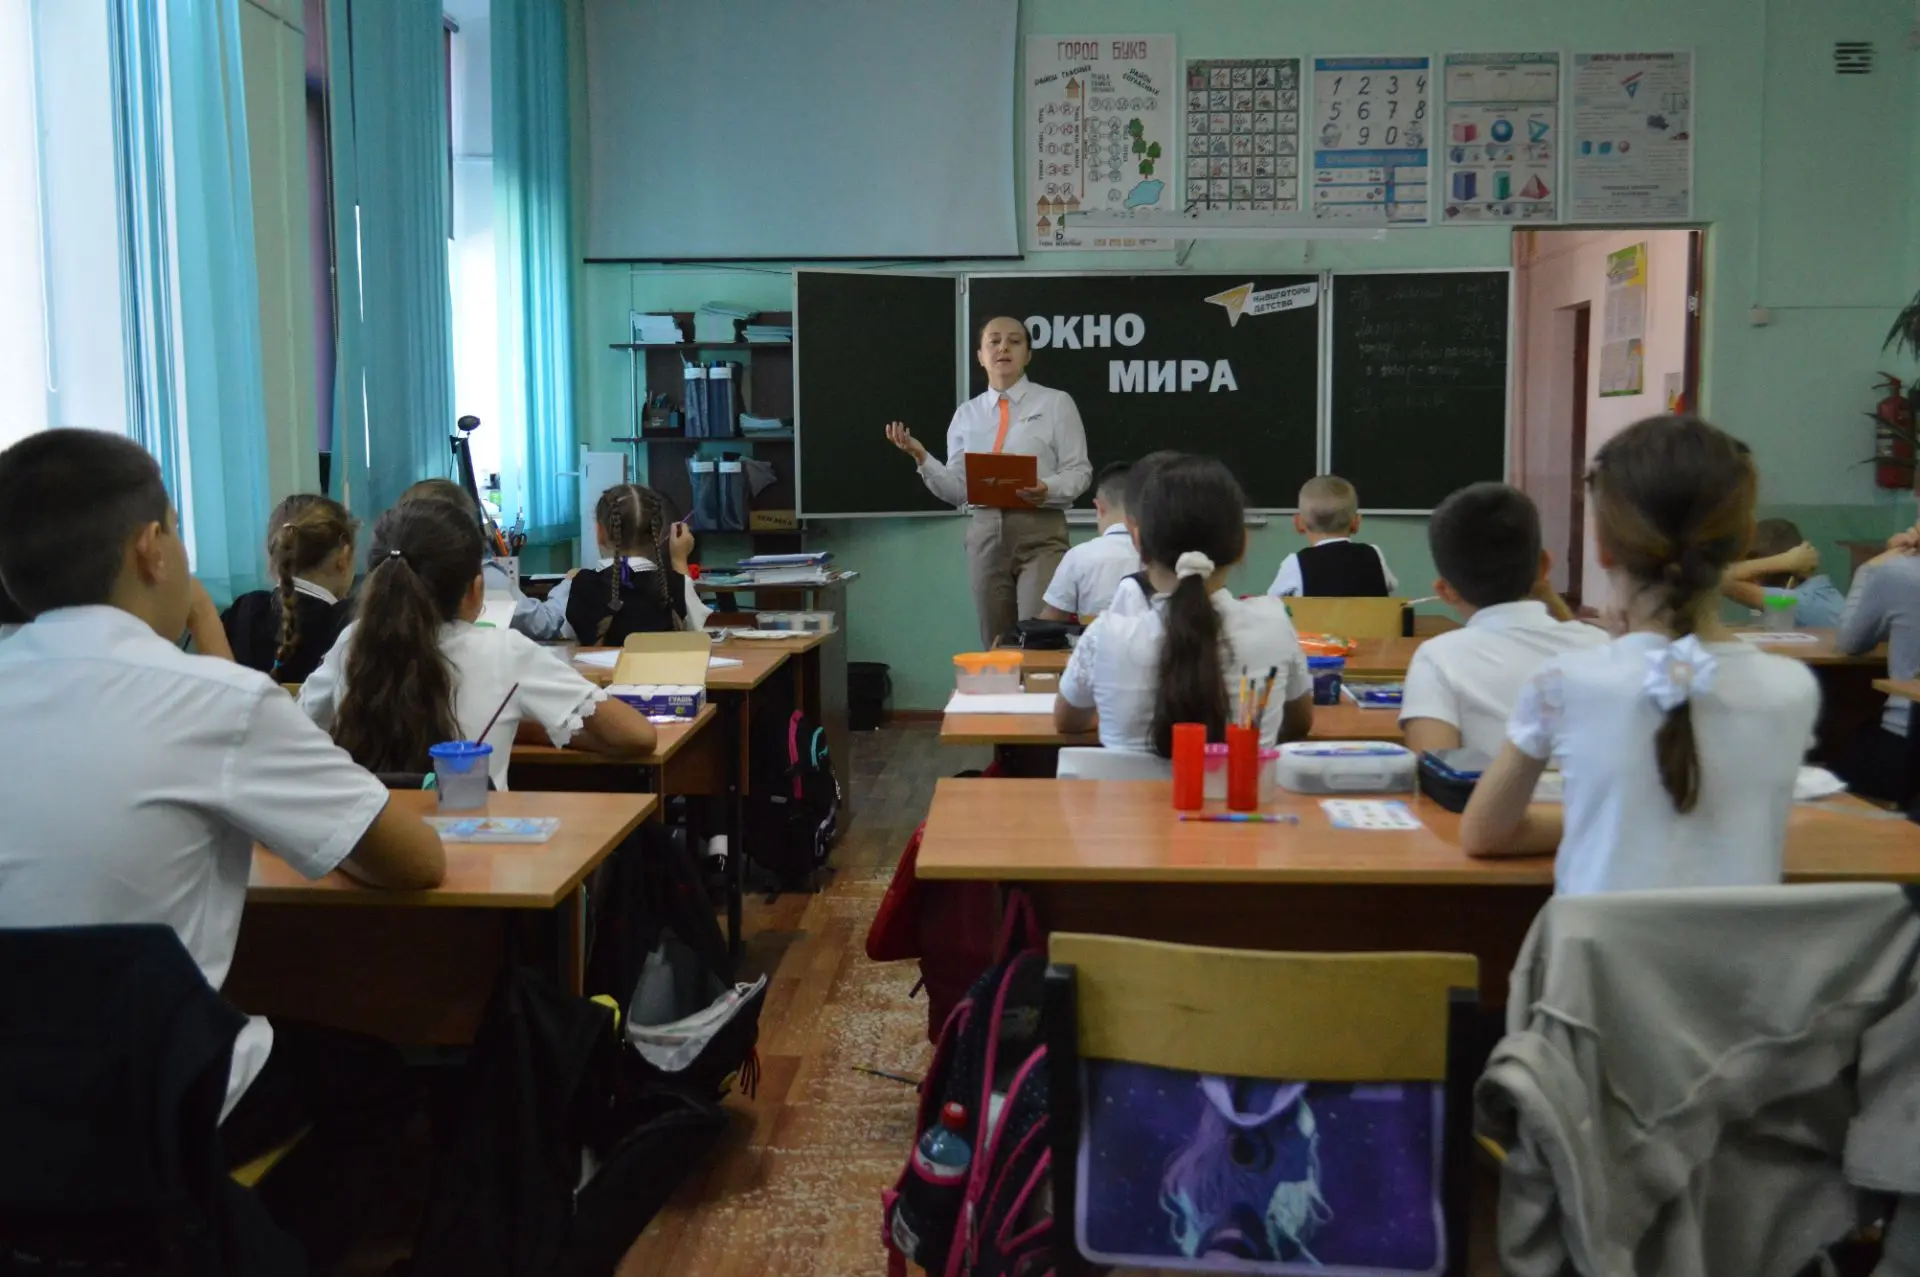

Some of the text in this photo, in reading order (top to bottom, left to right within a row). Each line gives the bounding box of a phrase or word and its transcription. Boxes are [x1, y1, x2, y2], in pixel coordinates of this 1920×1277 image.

[1057, 41, 1148, 60] ГОРОД БУКВ
[1333, 75, 1427, 96] 1 2 3 4
[1328, 100, 1426, 121] 5 6 7 8
[1357, 126, 1398, 146] 9 0
[1252, 286, 1311, 302] НАВИГАТОРЫ
[1254, 299, 1293, 313] ДЕТСТВА
[1023, 313, 1146, 350] ОКНО
[1109, 359, 1239, 393] МИРА
